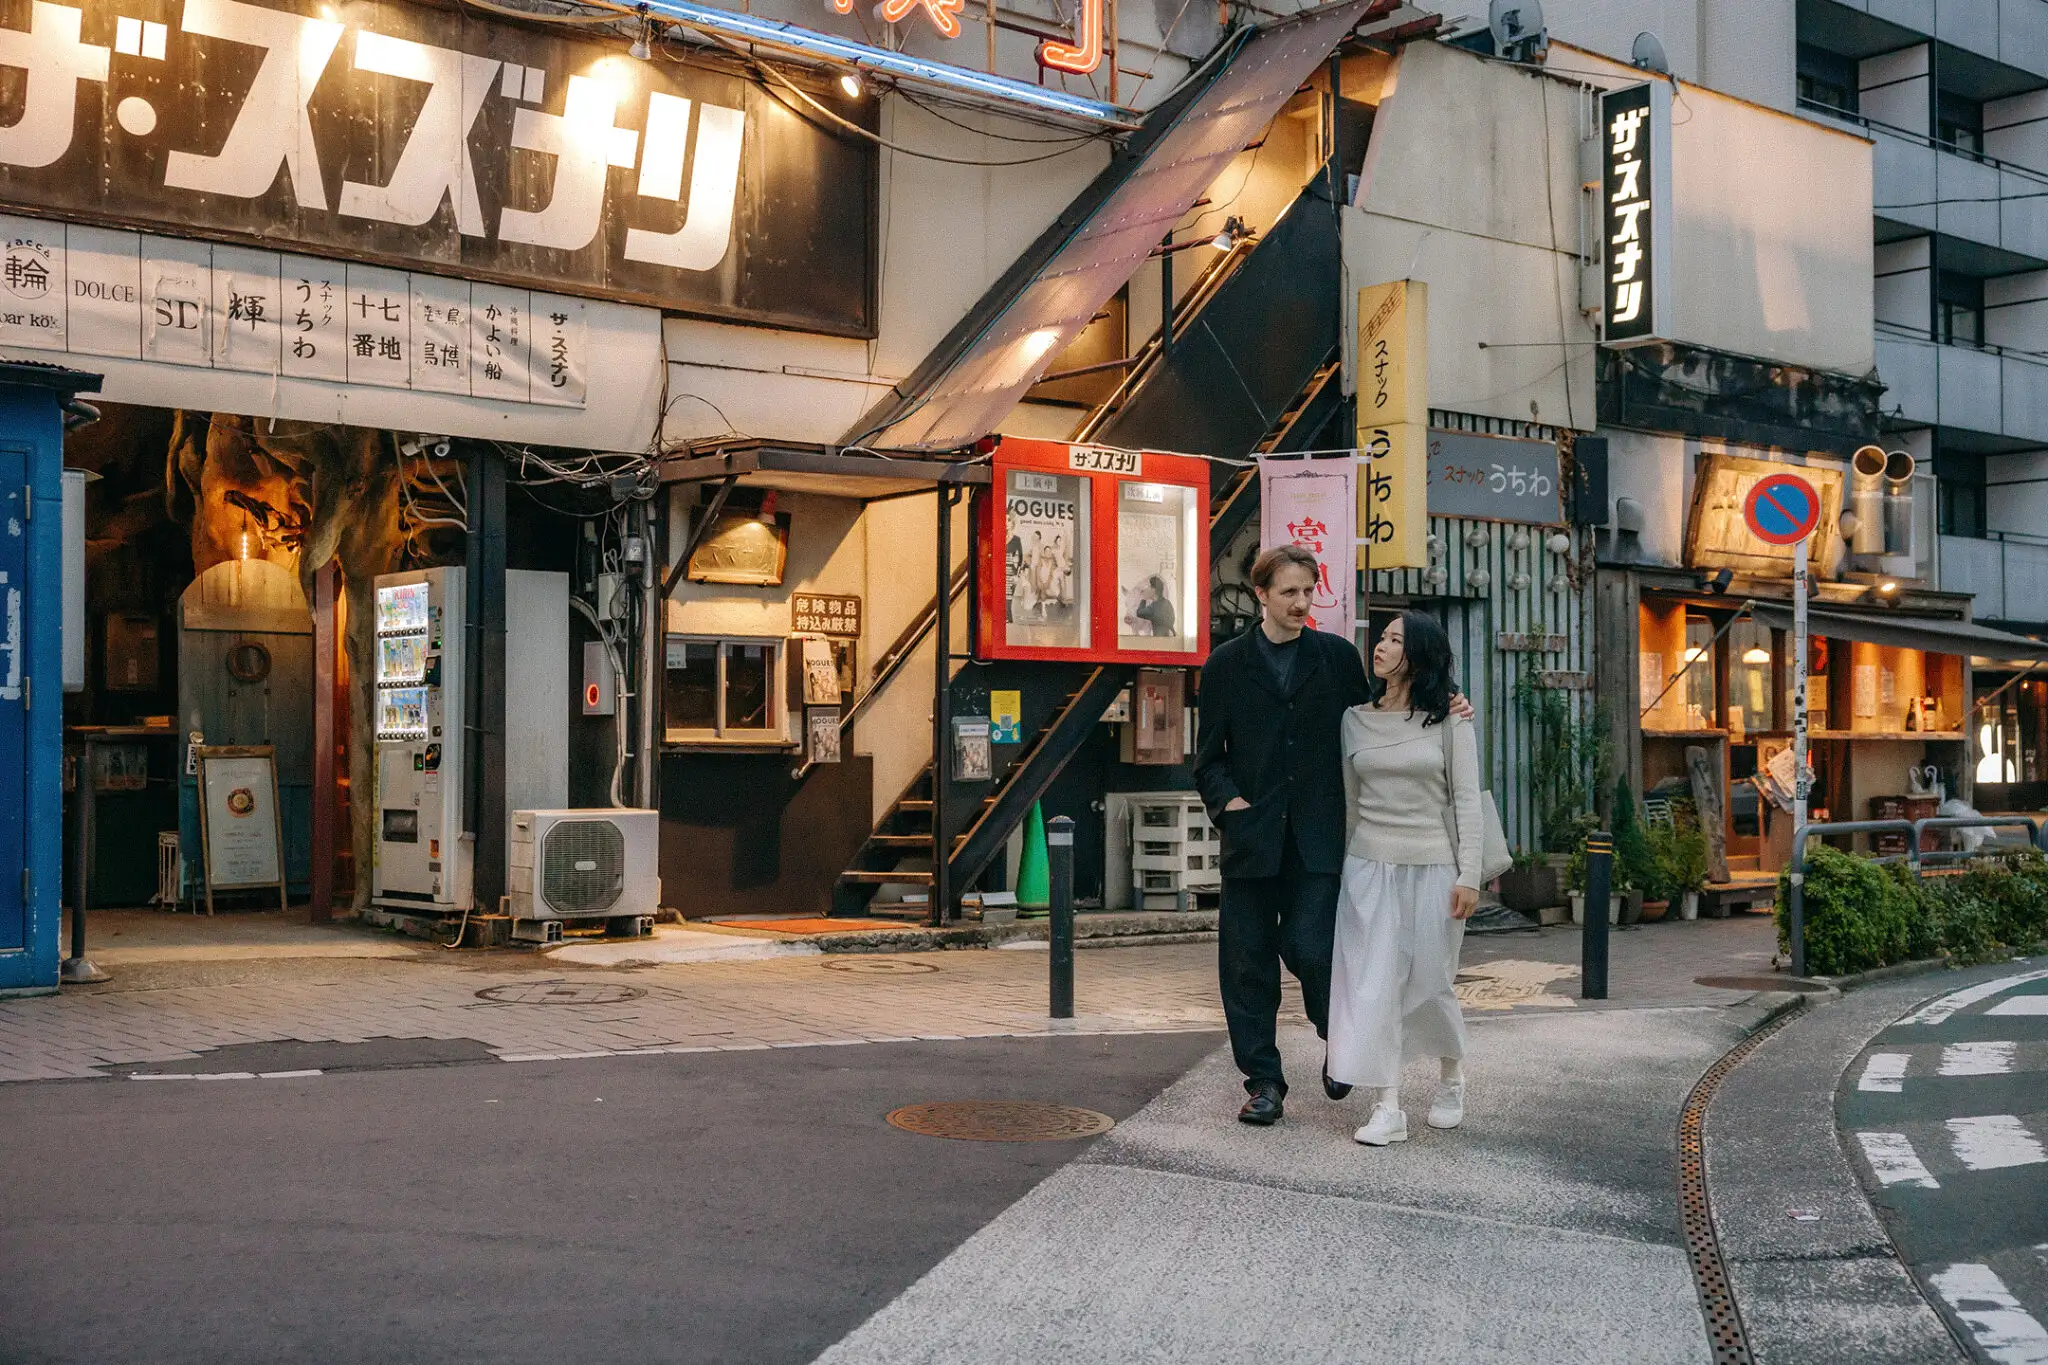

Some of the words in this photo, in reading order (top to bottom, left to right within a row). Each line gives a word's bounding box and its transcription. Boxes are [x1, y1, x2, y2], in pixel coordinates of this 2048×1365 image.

[1611, 106, 1650, 324] ザ・スズナリ
[4, 255, 49, 291] 輪
[74, 279, 134, 302] DOLCE
[229, 292, 267, 331] 輝
[293, 279, 316, 359] うちわ
[319, 280, 333, 325] スナック
[352, 294, 400, 322] 十七
[352, 333, 401, 361] 番地
[485, 303, 503, 381] かよい船
[550, 312, 569, 387] ザ・スズナリ
[1374, 339, 1389, 408] スナック
[1369, 429, 1394, 544] うちわ
[1444, 465, 1485, 485] スナック
[1489, 463, 1550, 497] うちわ
[795, 598, 857, 615] 危険物品
[796, 615, 857, 632] 持込み厳禁
